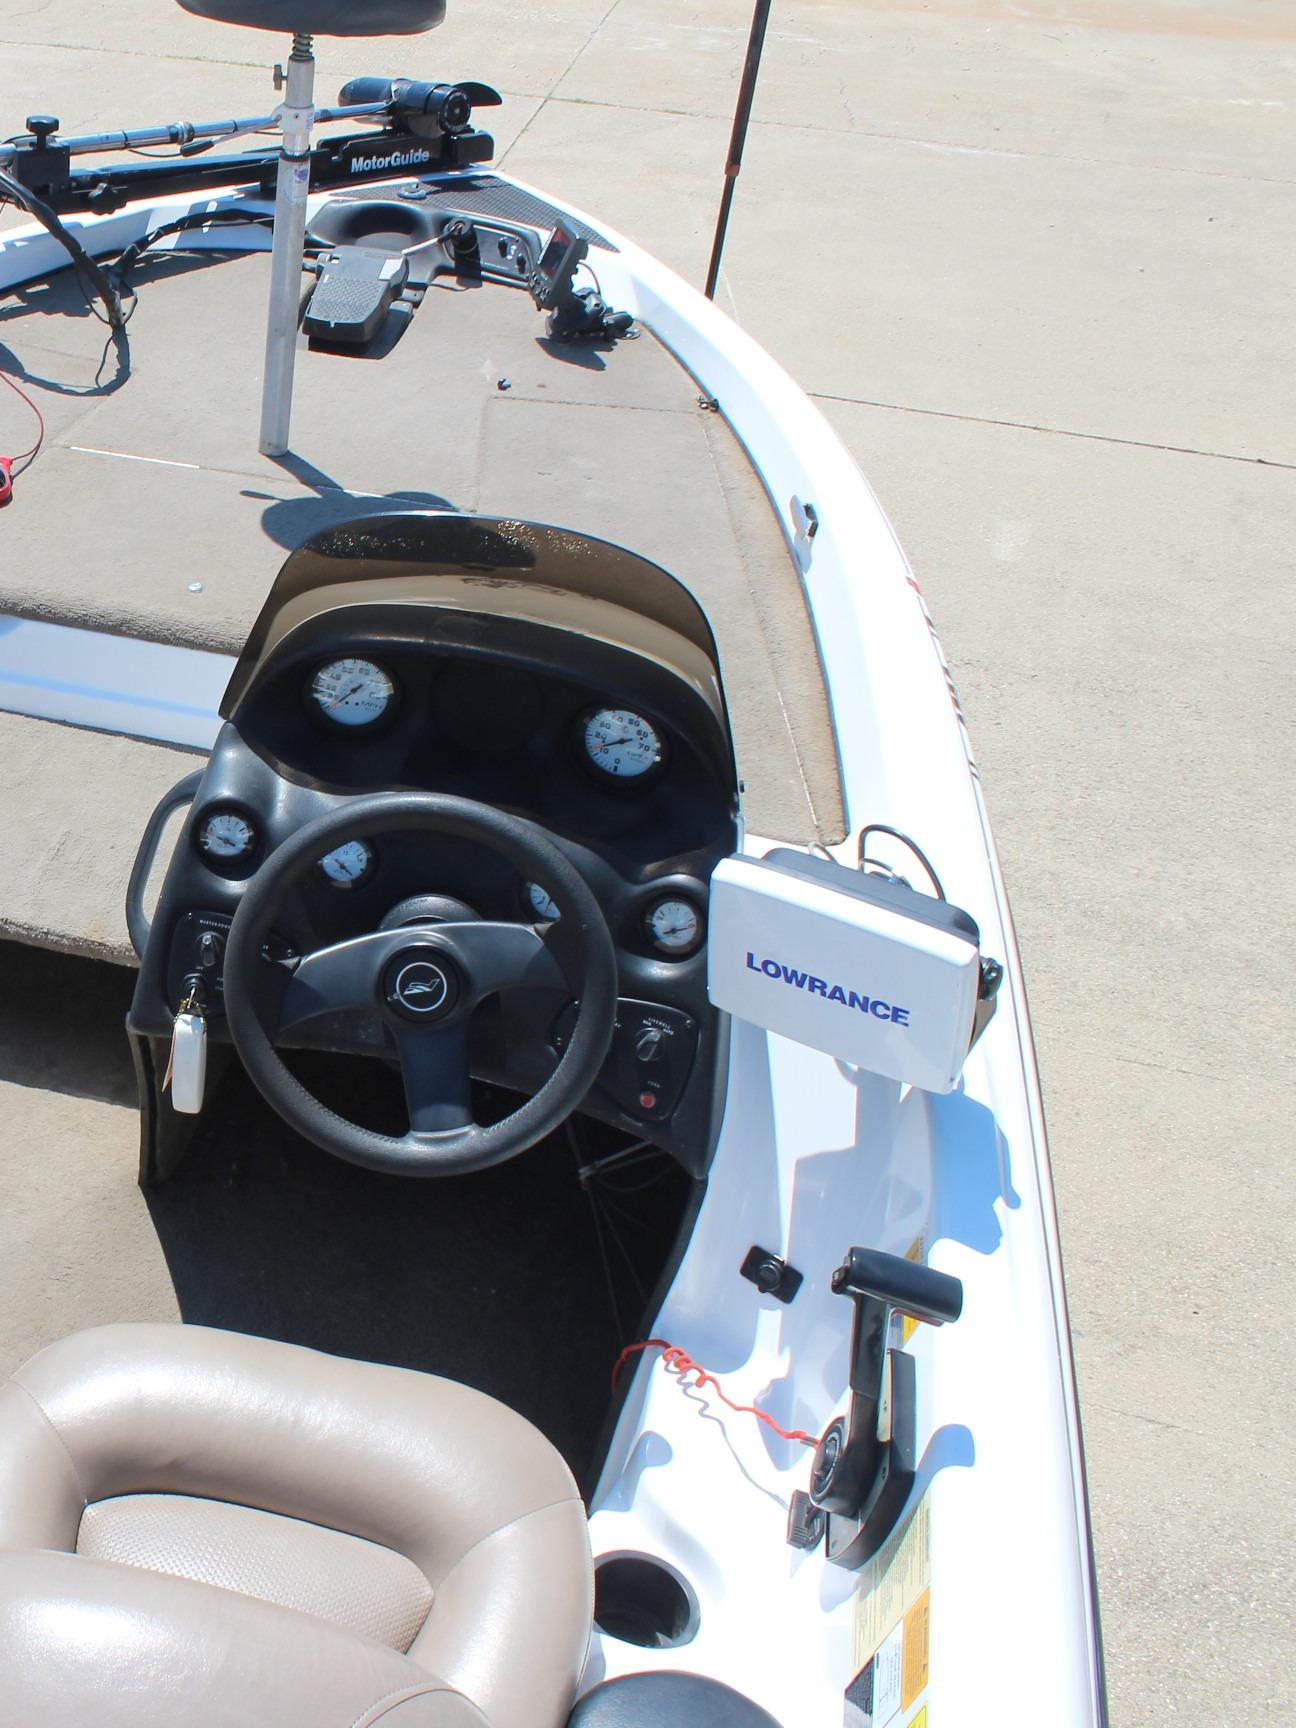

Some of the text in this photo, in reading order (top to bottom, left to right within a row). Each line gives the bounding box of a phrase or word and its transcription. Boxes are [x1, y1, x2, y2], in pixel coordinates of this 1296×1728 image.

[350, 148, 430, 173] MotorGuide
[638, 743, 650, 752] 70
[746, 952, 910, 1027] LOWRANCE
